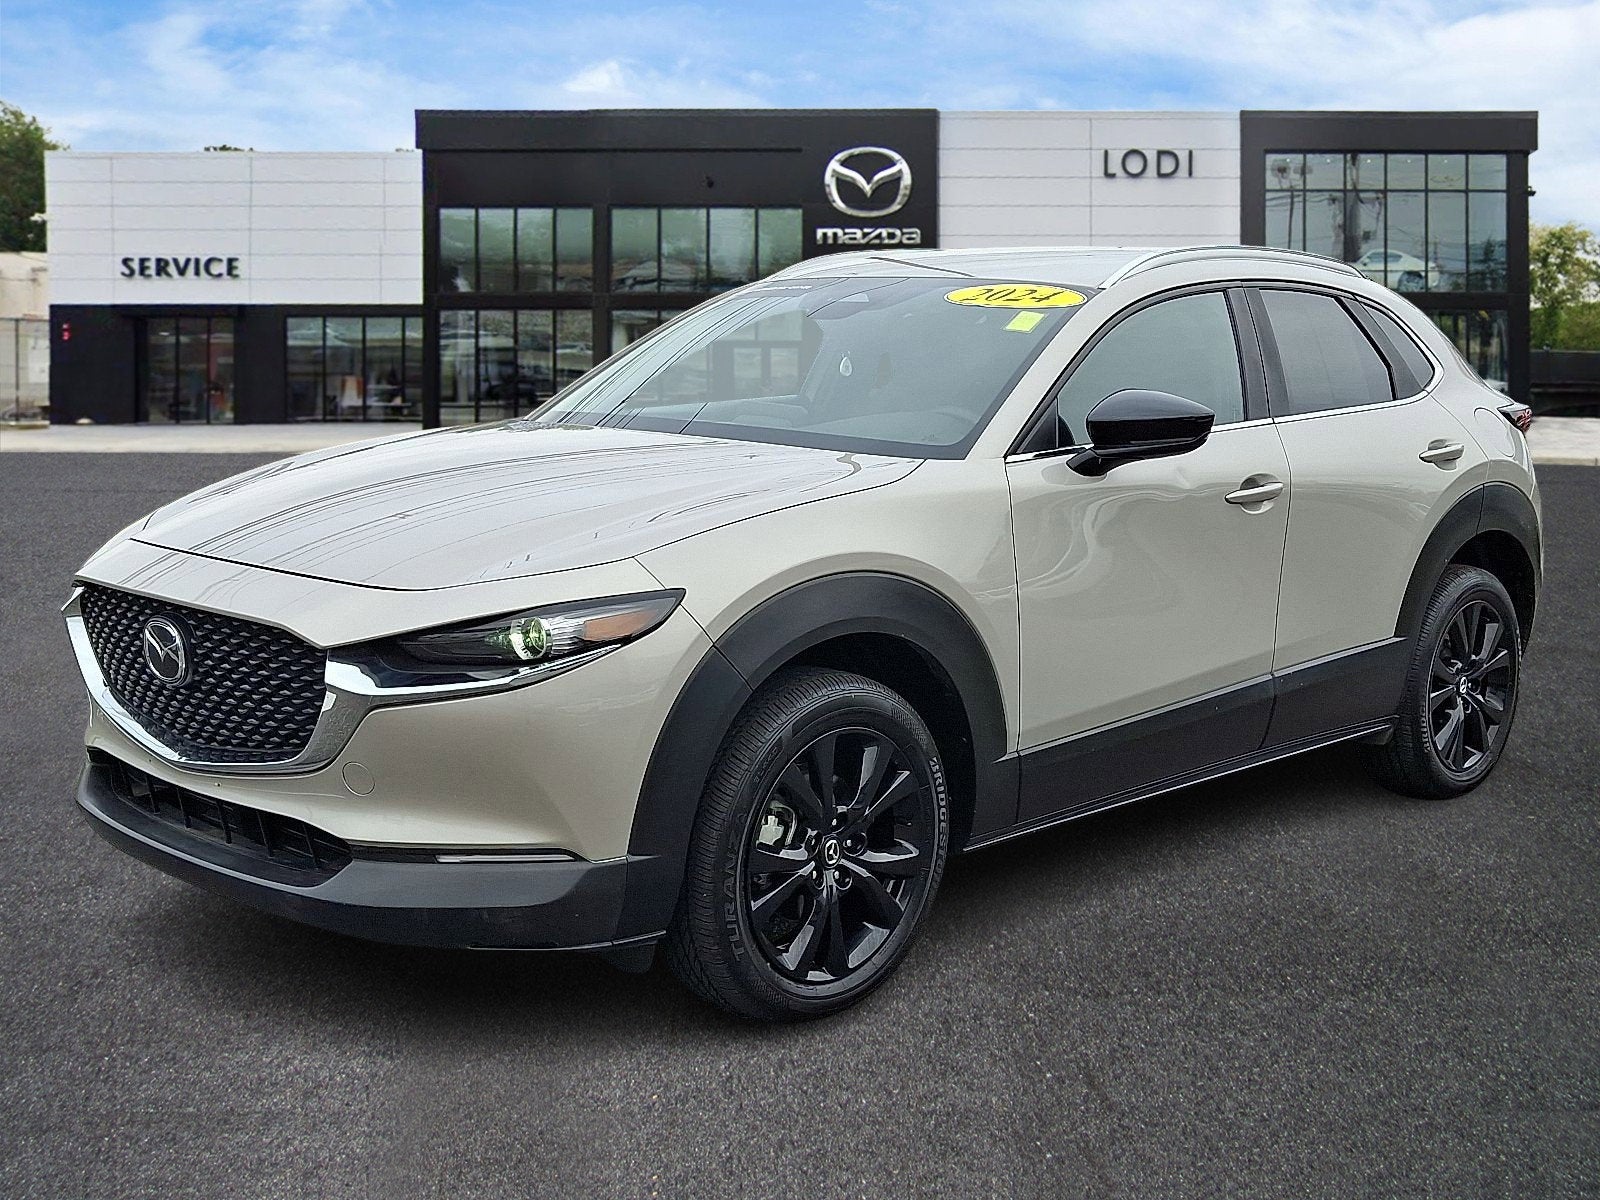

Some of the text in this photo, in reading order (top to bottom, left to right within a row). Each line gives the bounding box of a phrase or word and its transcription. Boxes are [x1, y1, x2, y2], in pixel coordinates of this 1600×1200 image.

[1103, 148, 1193, 178] LODI
[120, 257, 240, 279] SERVICE
[959, 288, 1065, 303] 2024
[928, 756, 947, 888] BRIDGESTO
